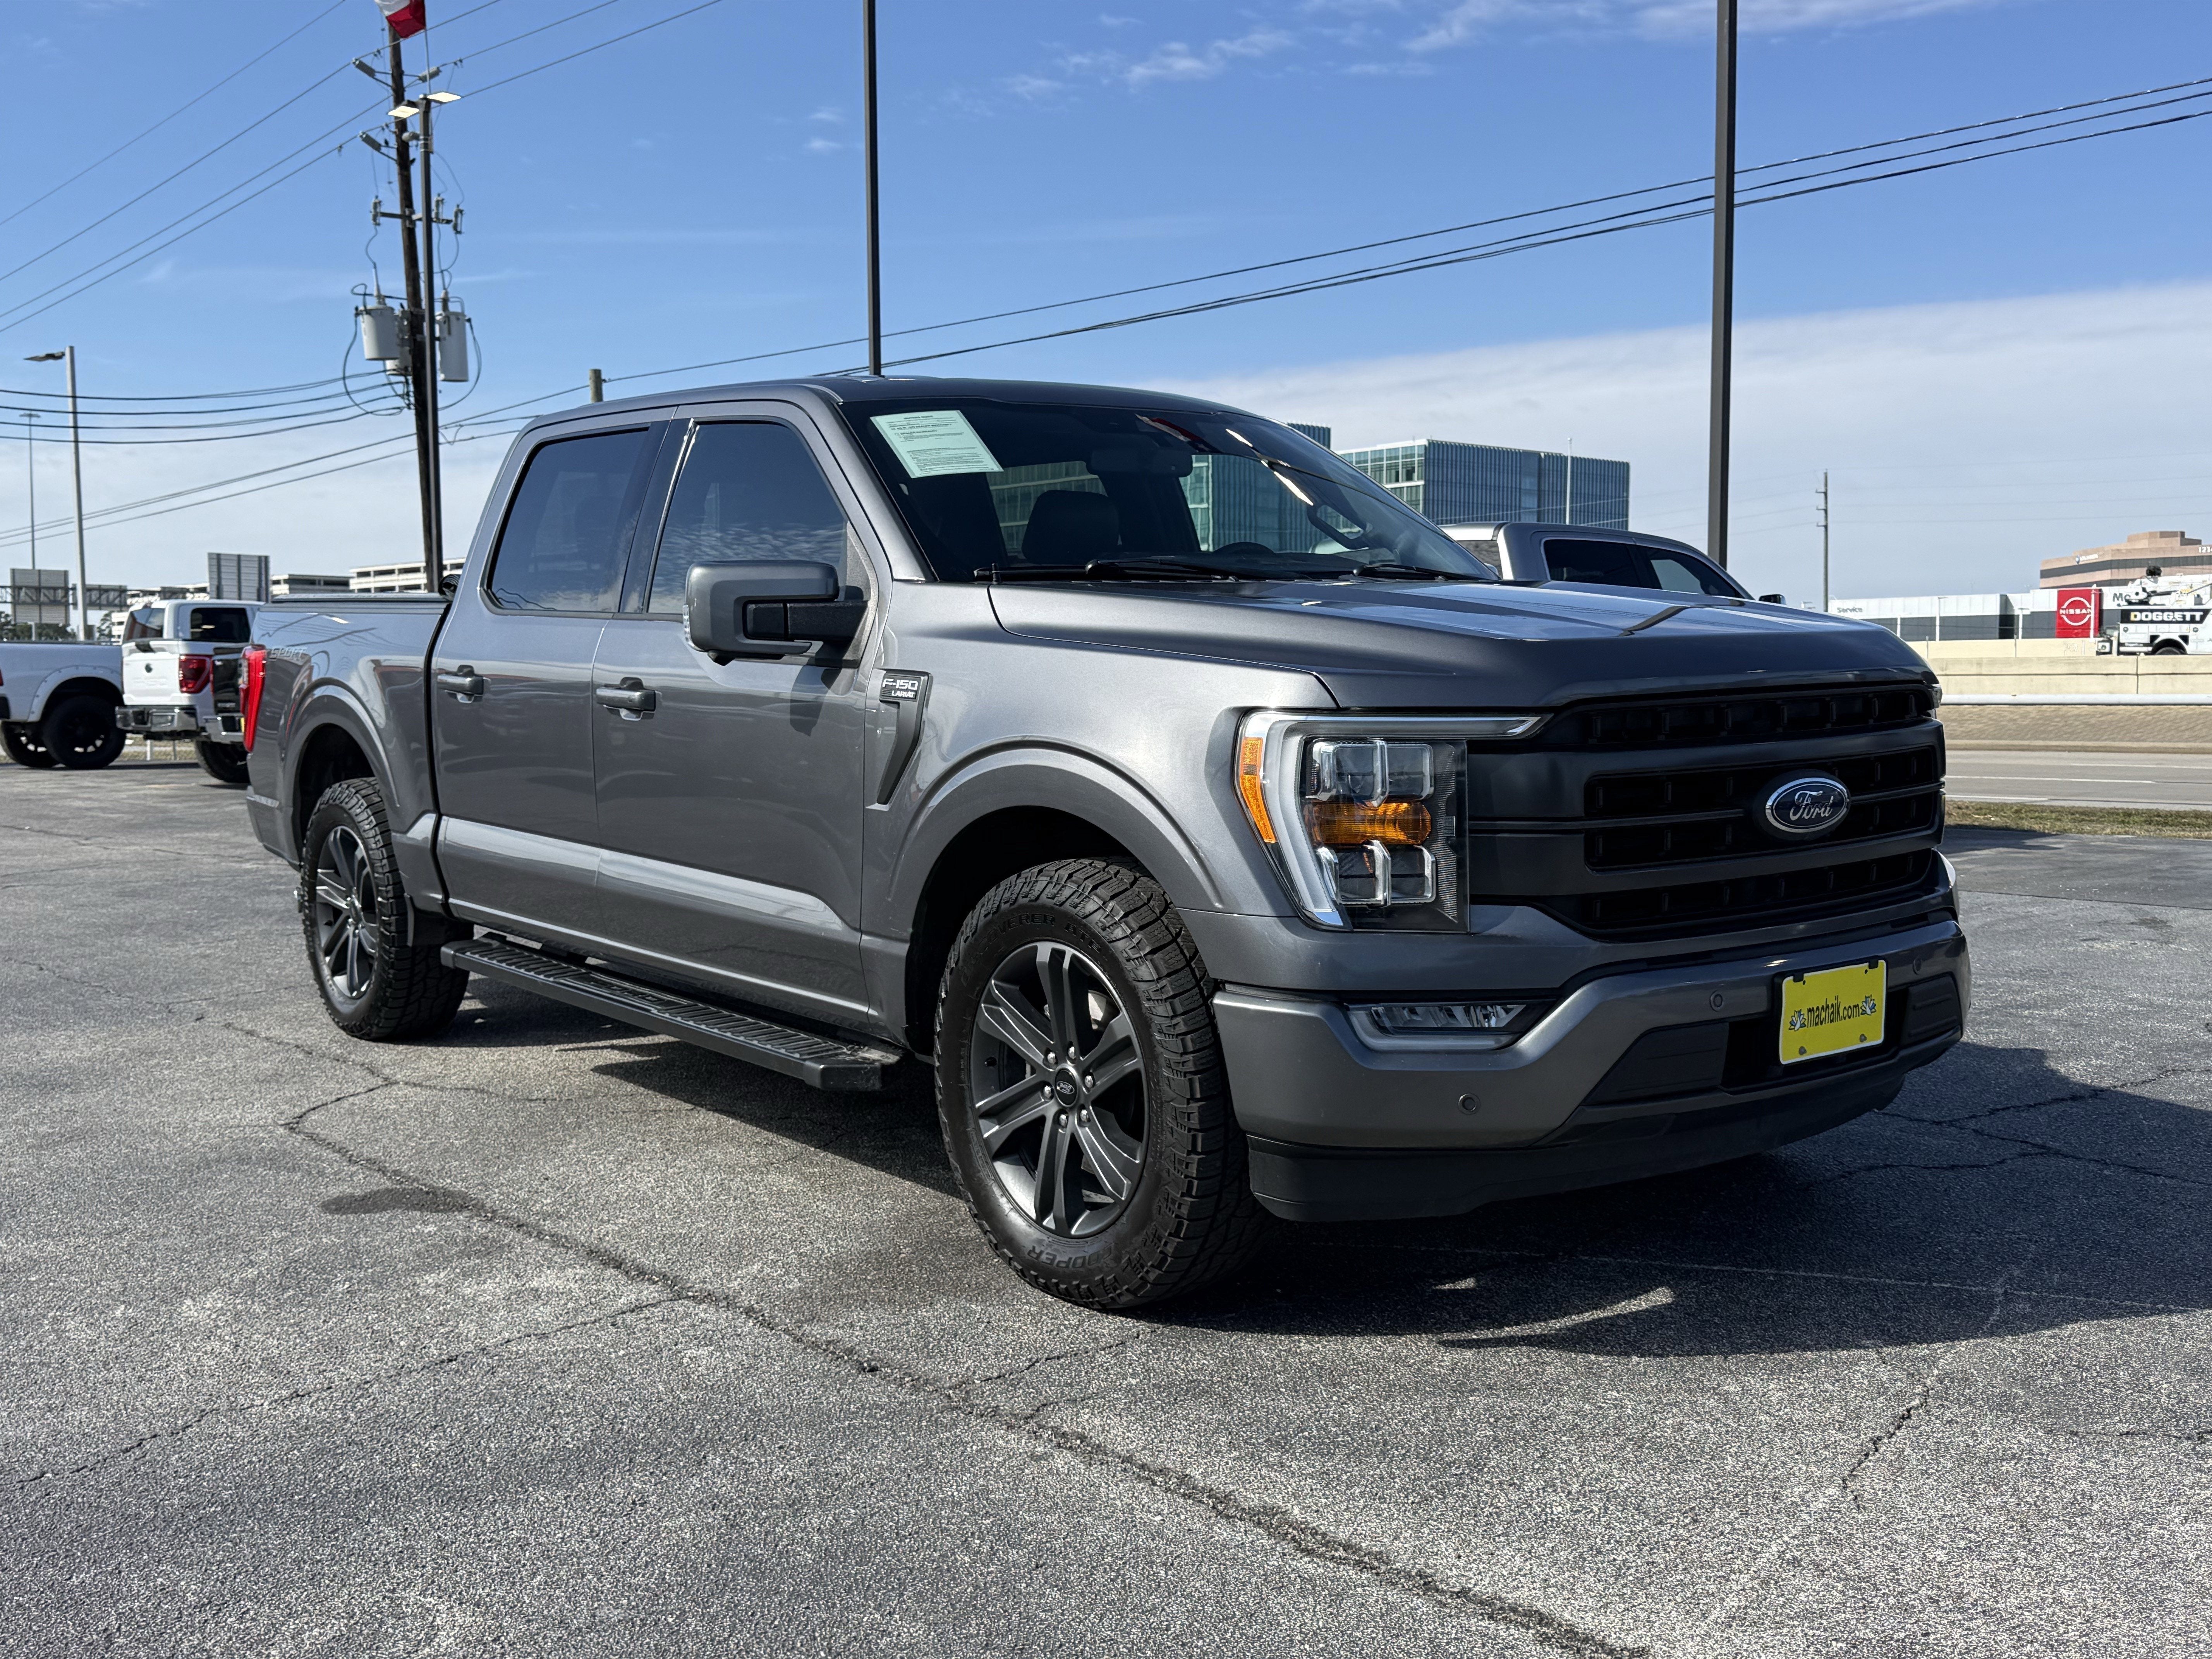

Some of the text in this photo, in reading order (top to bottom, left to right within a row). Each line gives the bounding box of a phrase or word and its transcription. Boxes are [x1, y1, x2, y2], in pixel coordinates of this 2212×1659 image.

[2130, 611, 2203, 622] DOGGETT
[883, 678, 918, 690] F-150
[1790, 790, 1834, 821] Ford
[1807, 995, 1860, 1028] machaik.com
[1027, 1242, 1115, 1269] COOPER
